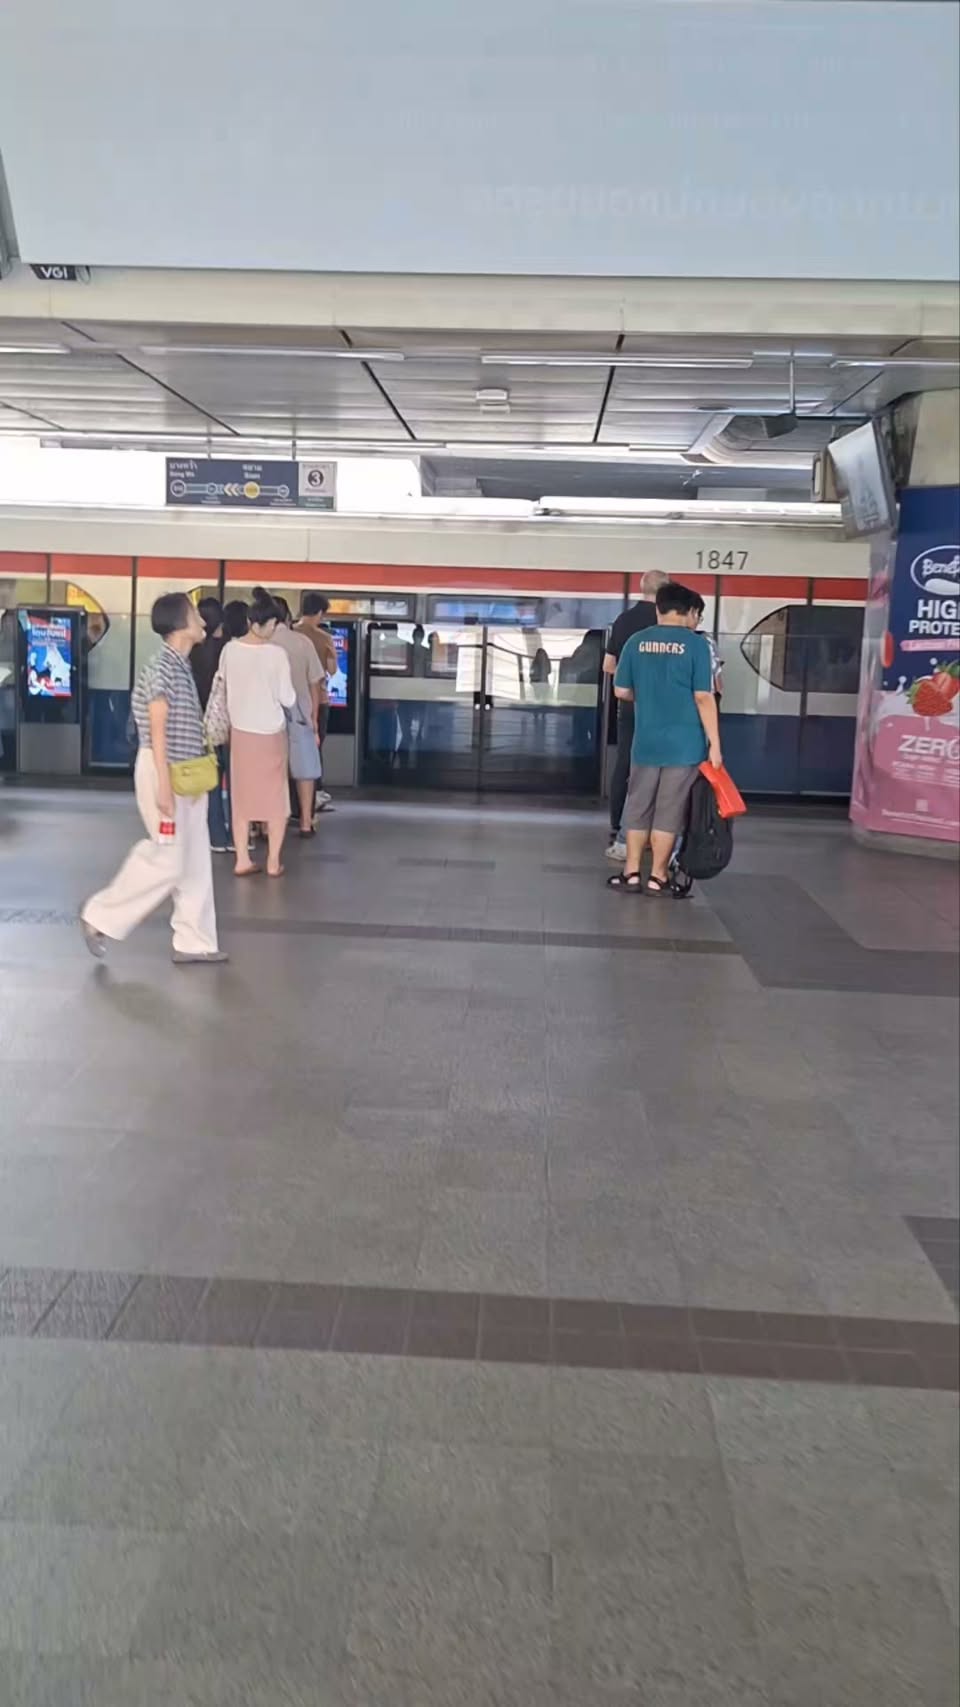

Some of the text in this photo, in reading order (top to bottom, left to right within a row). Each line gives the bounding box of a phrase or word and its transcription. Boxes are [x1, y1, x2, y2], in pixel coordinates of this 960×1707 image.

[40, 266, 68, 279] VGI
[311, 470, 321, 487] 3
[696, 550, 749, 570] 1847
[638, 641, 686, 655] GUNNERS
